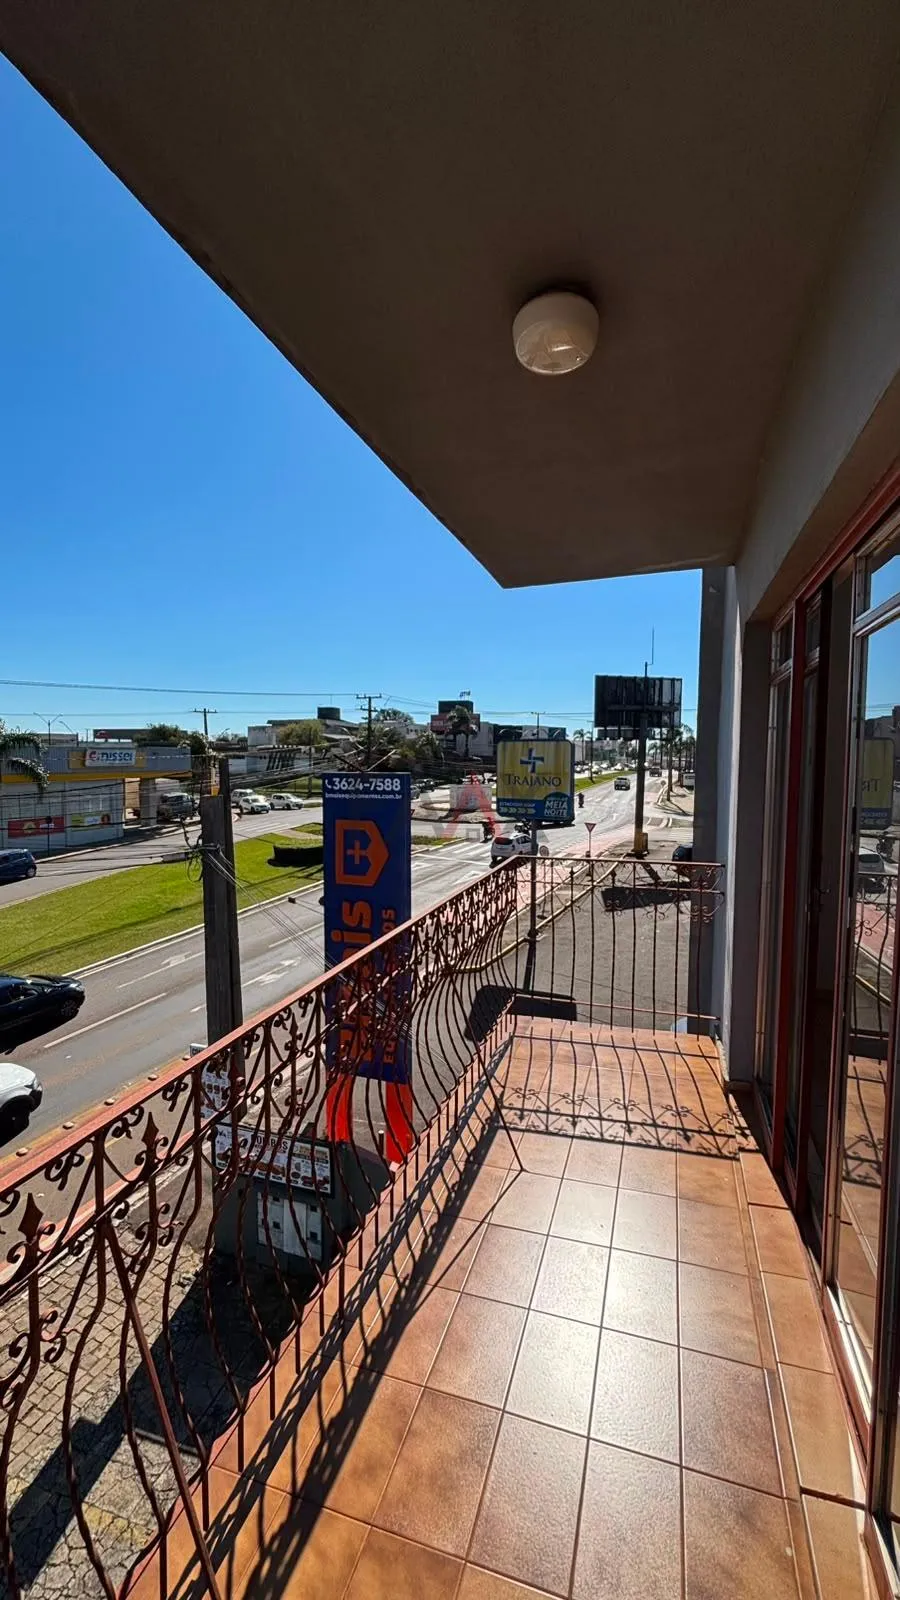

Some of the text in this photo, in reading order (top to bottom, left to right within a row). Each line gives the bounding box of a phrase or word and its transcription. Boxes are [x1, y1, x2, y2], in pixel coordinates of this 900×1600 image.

[332, 777, 401, 791] 3624-7588
[504, 773, 562, 787] TRAJANO
[545, 800, 568, 809] MEIA
[544, 808, 568, 817] NOITE
